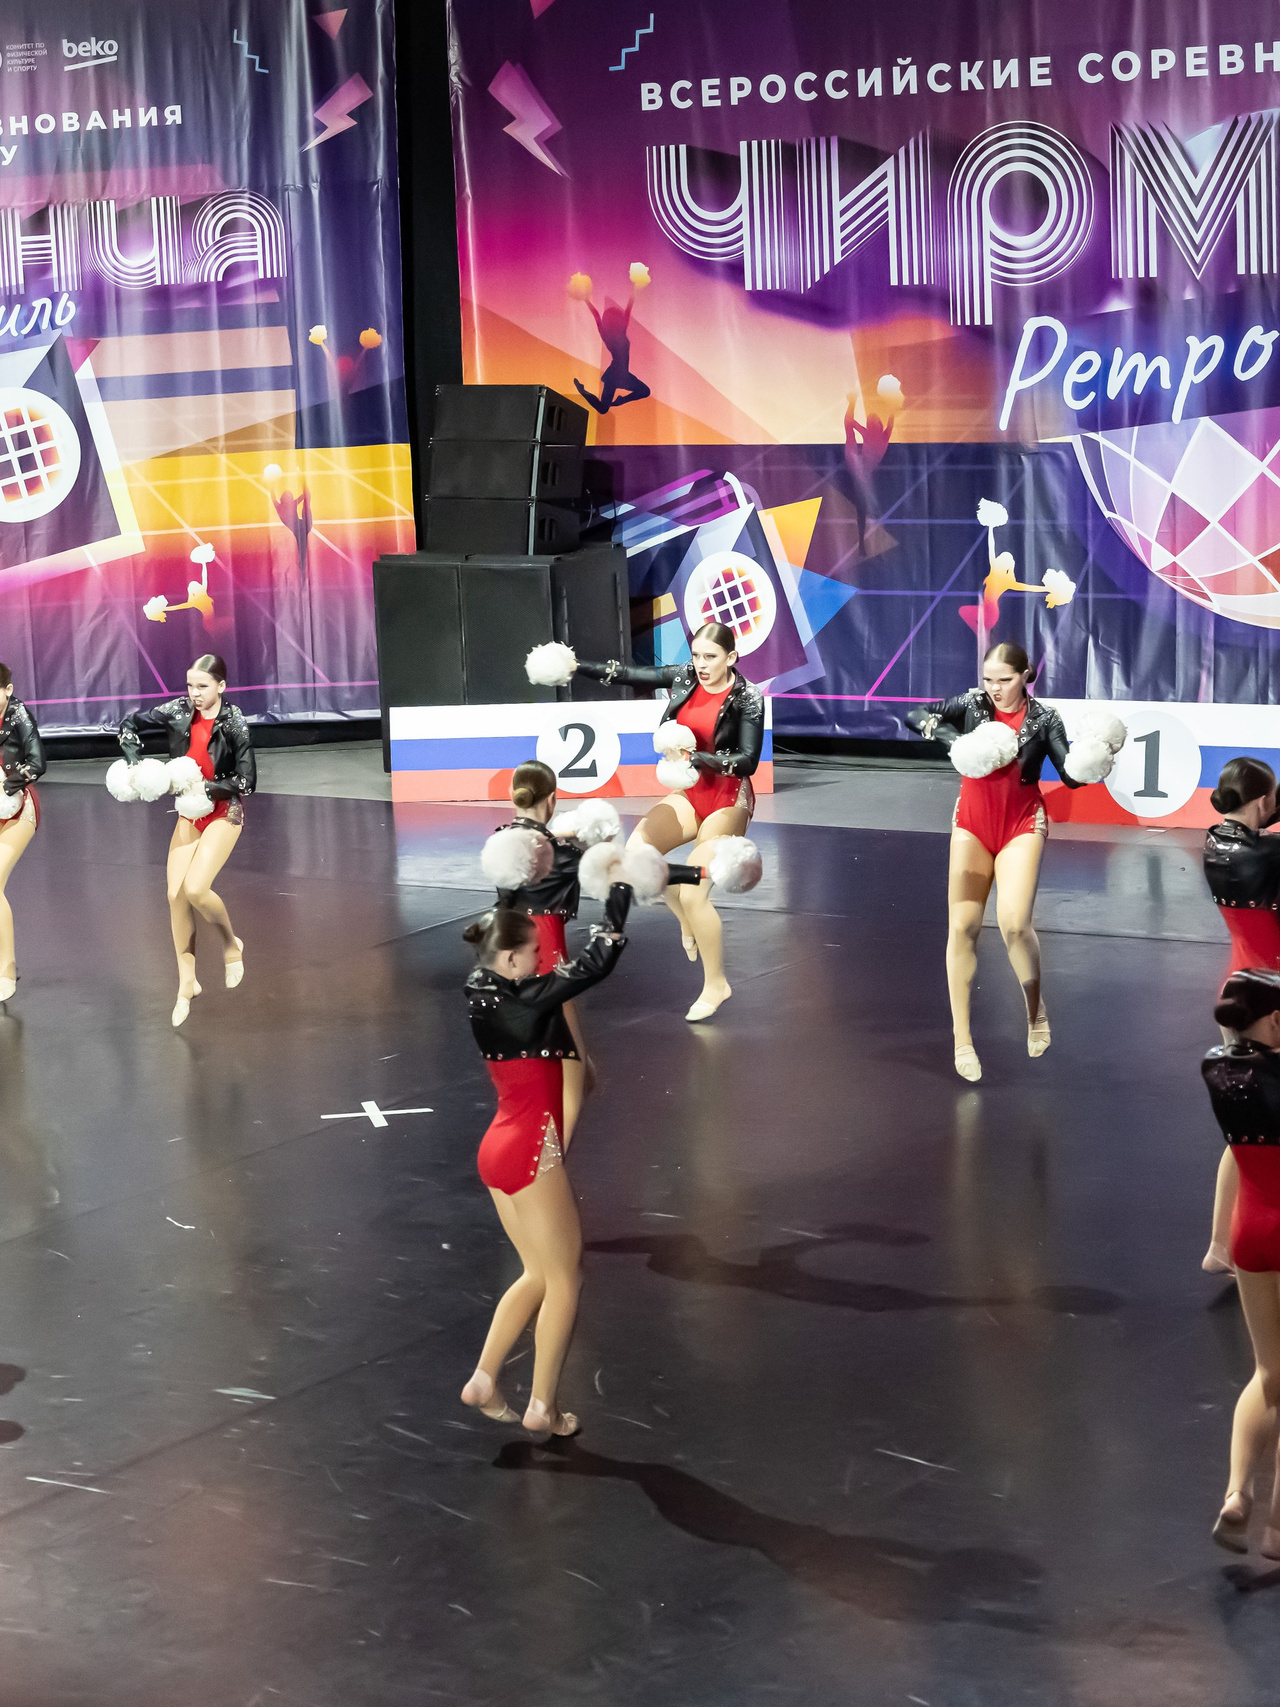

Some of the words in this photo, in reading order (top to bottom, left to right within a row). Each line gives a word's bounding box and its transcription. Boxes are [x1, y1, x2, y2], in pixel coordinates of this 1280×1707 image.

[6, 48, 47, 58] ФИЗИЧЕСКОЙ
[62, 37, 118, 58] beko
[641, 56, 1052, 111] ВСЕРОССИЙСКИЕ
[1077, 41, 1280, 84] СОРЕВН
[999, 315, 1280, 431] Ретро
[558, 723, 598, 778] 2
[1133, 730, 1169, 798] 1
